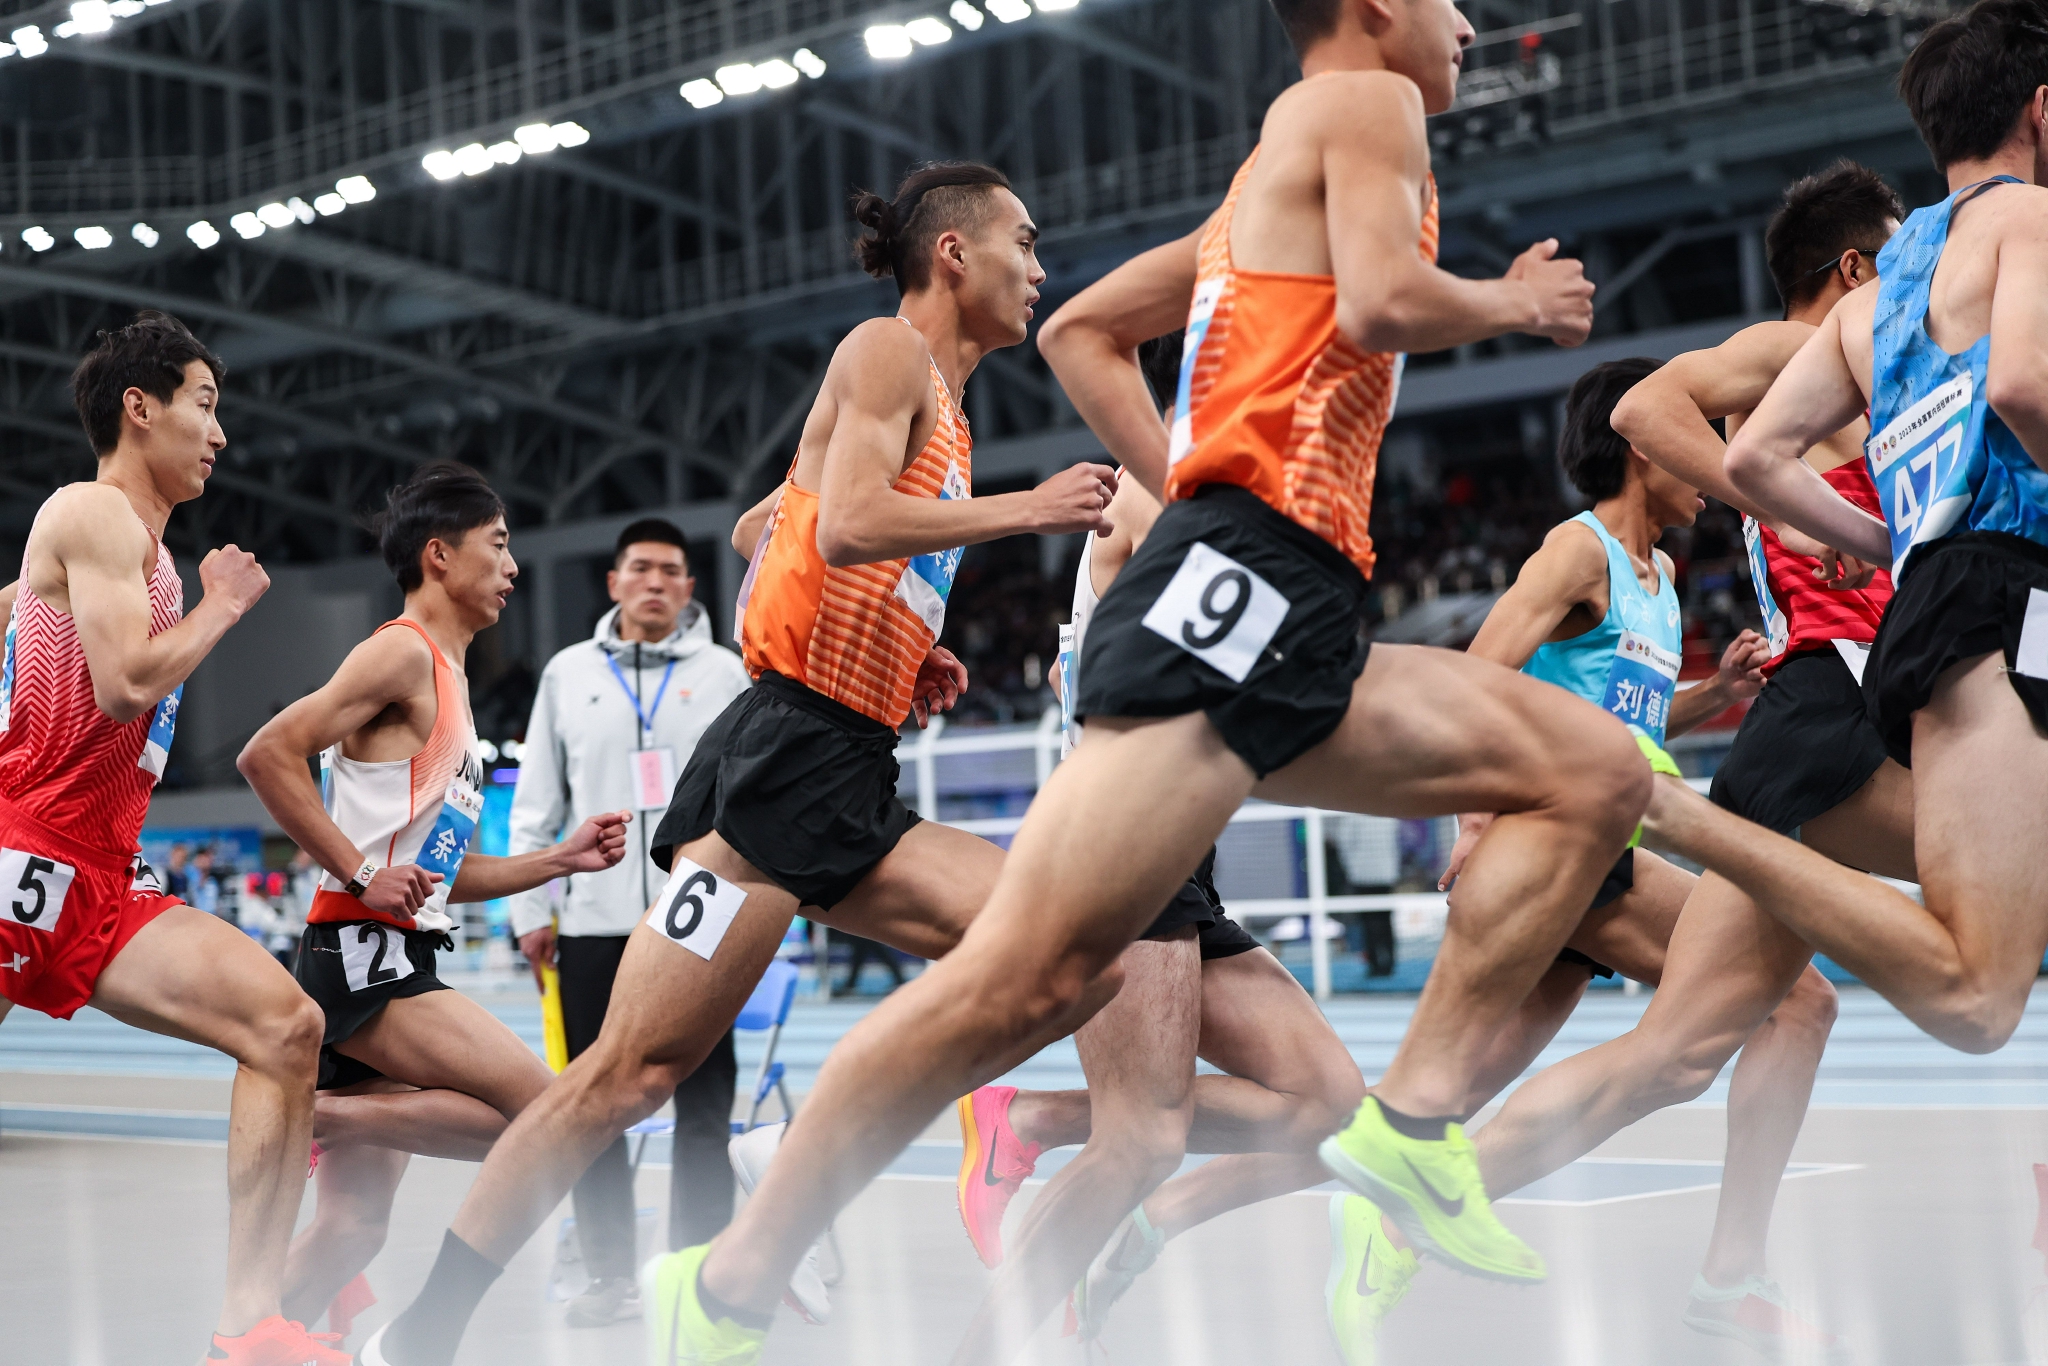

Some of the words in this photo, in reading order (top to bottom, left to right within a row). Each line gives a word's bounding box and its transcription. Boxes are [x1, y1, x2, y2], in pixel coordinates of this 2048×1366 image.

[1894, 421, 1964, 541] 477
[1182, 569, 1252, 649] 9
[12, 856, 55, 924] 5
[665, 870, 717, 940] 6
[358, 922, 398, 985] 2
